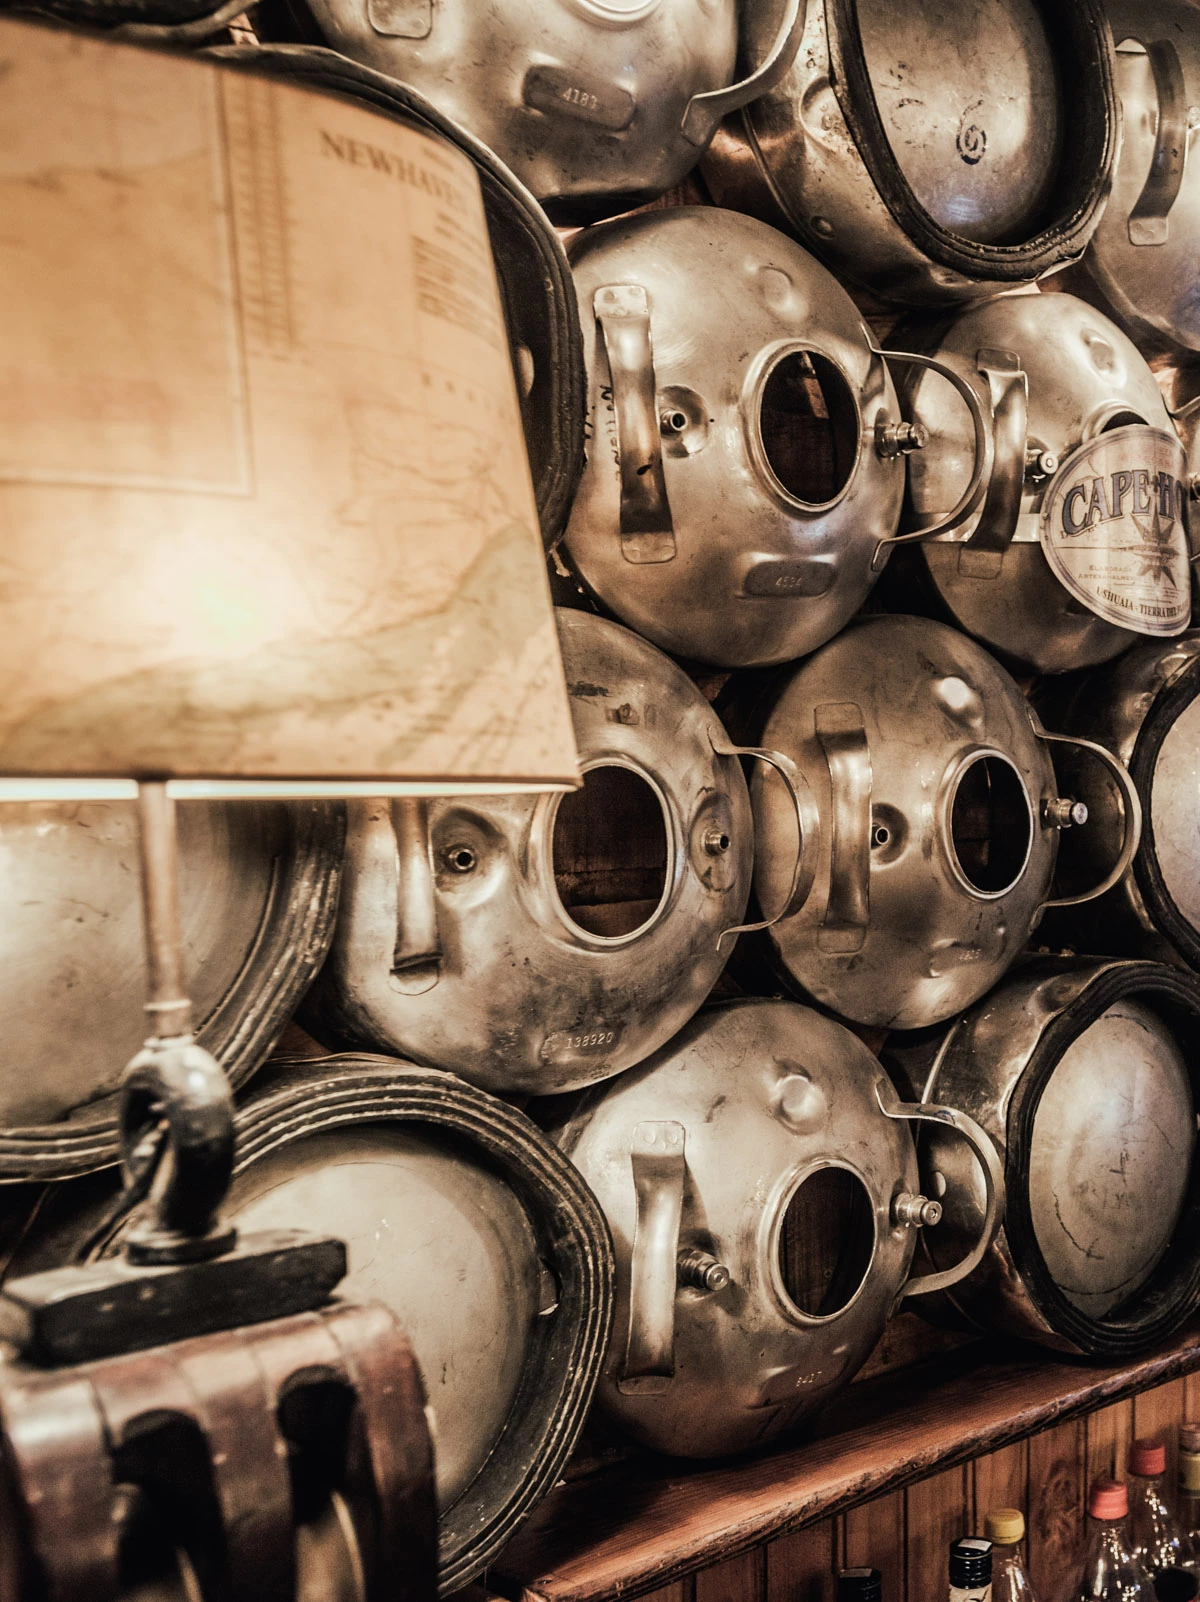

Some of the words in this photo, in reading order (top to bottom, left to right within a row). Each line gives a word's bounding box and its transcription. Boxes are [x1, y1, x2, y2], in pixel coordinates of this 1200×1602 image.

[563, 88, 598, 109] 4183
[1062, 469, 1151, 535] CAPE
[1097, 586, 1133, 611] USHUAIA
[565, 1032, 614, 1049] 138920
